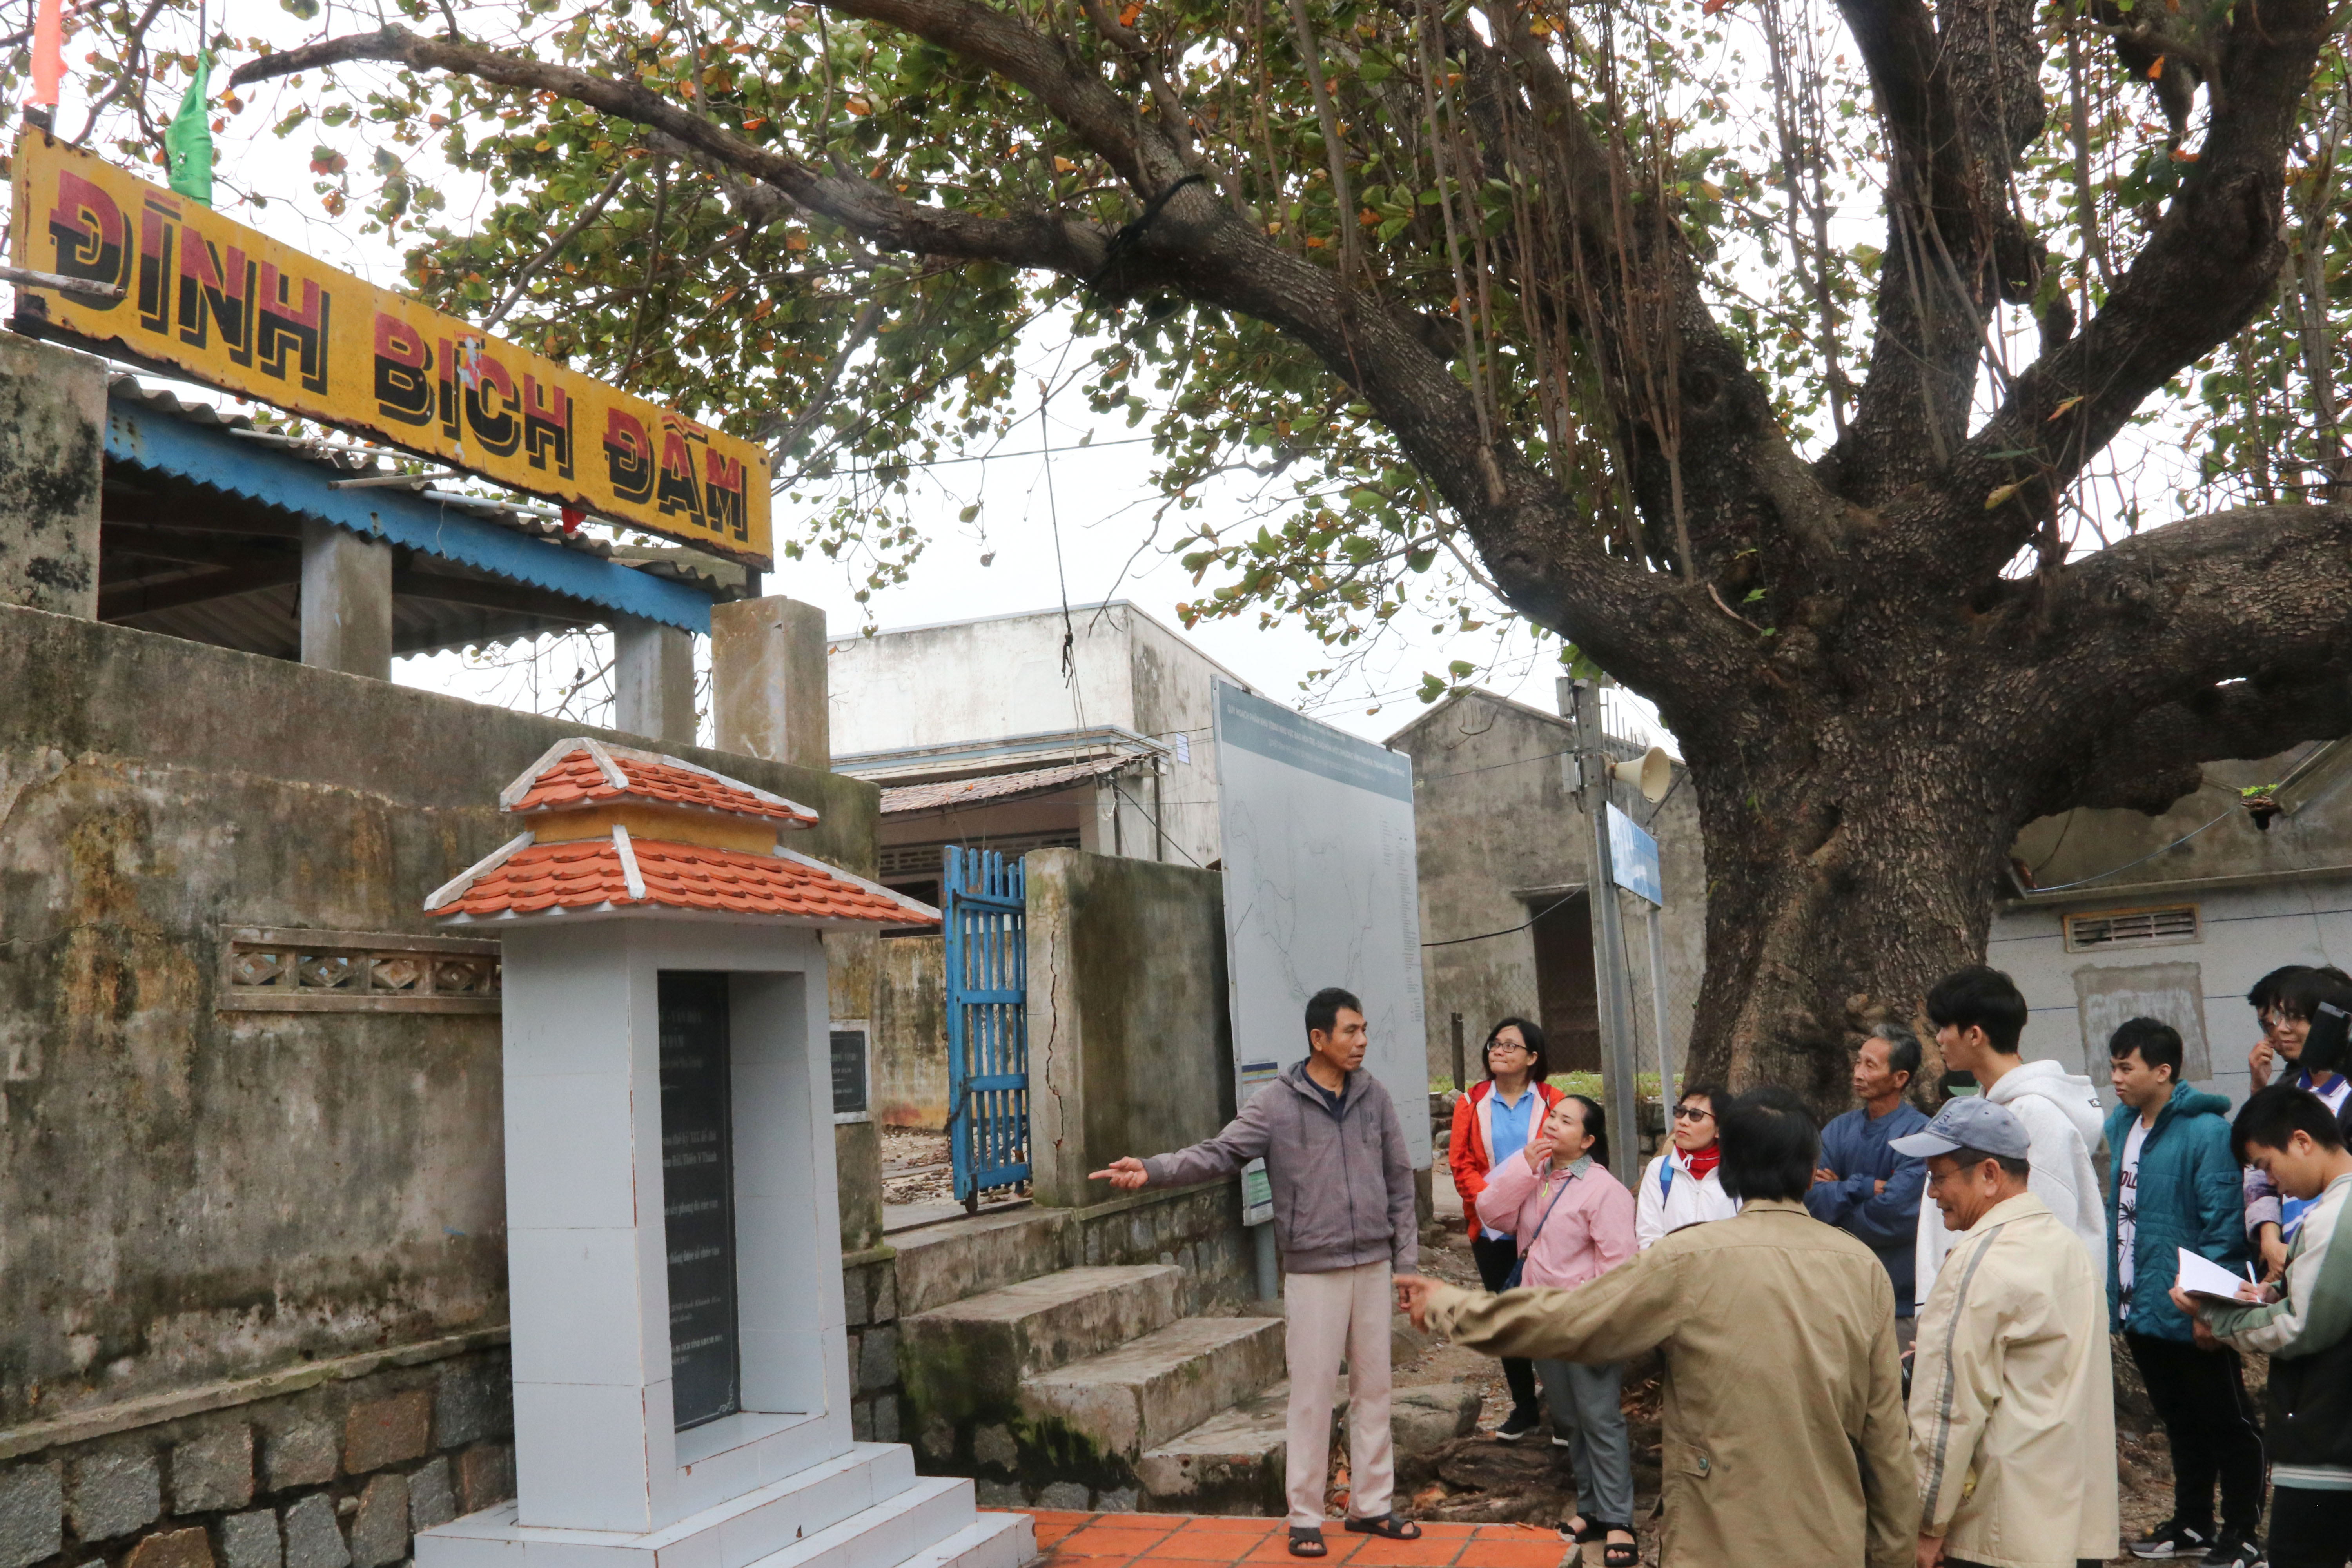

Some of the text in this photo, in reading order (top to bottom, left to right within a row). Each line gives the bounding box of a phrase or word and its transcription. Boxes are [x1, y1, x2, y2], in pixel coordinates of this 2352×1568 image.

[49, 169, 749, 543] ĐÌNH BÍCH ĐẦM
